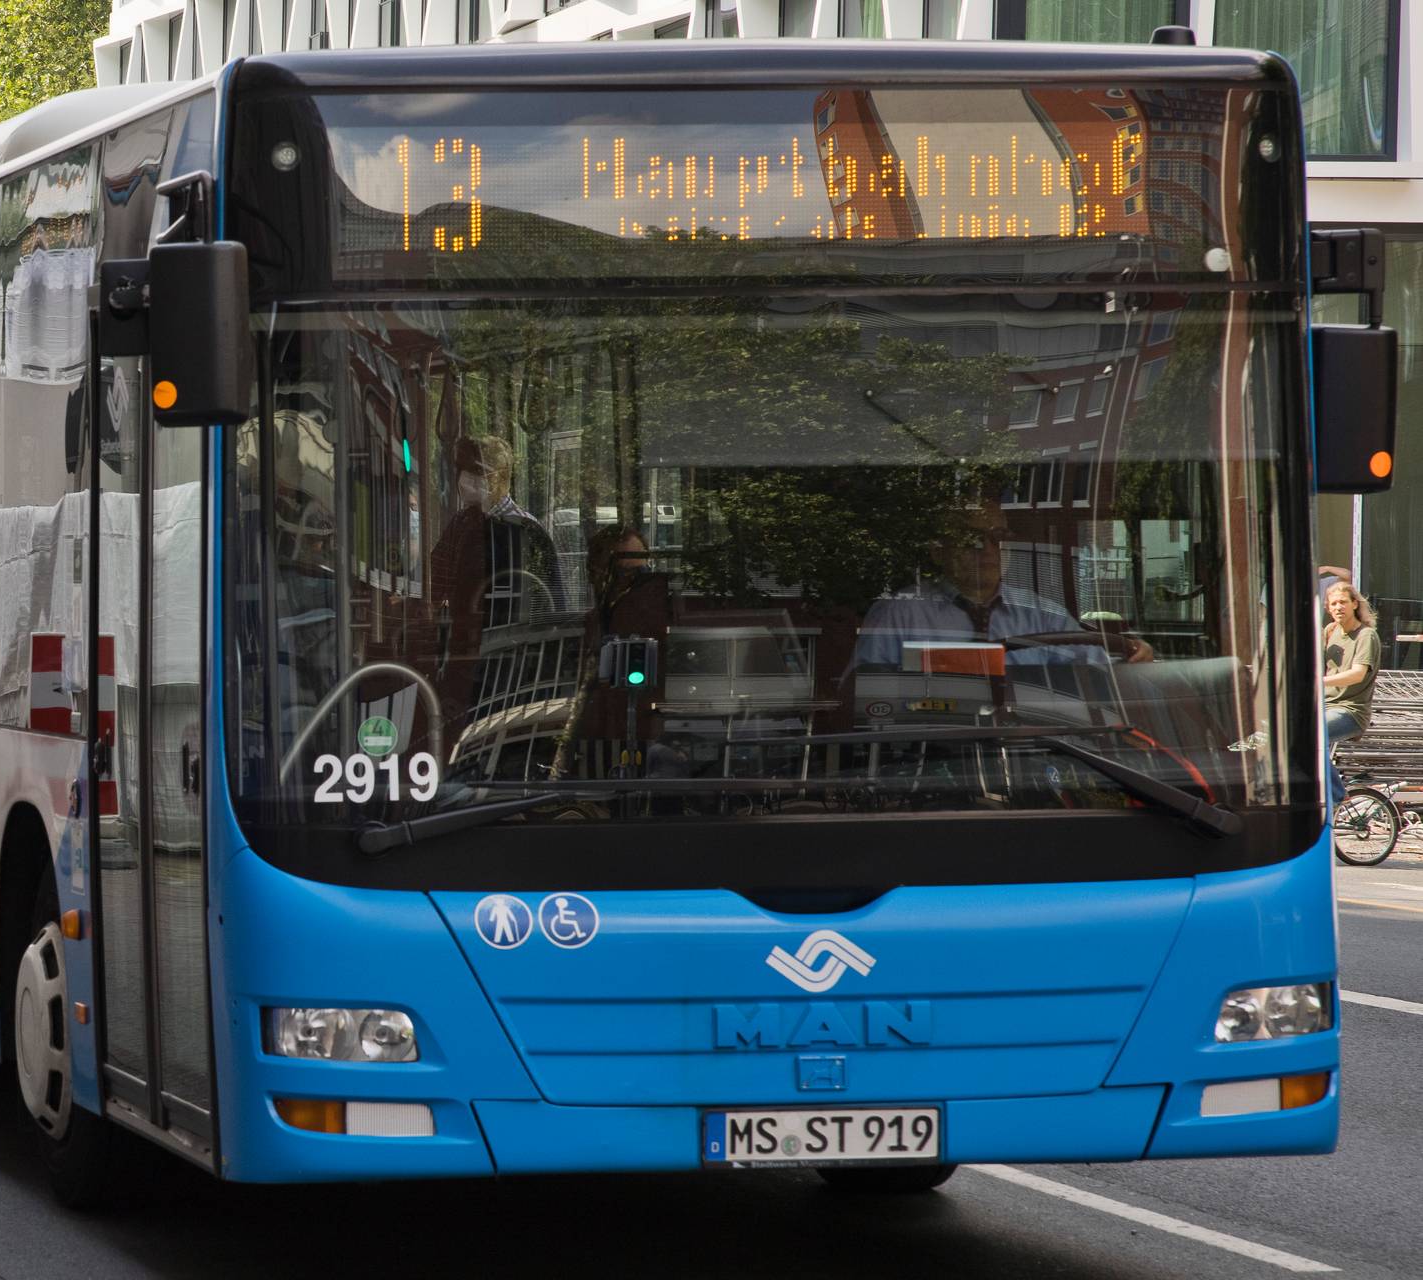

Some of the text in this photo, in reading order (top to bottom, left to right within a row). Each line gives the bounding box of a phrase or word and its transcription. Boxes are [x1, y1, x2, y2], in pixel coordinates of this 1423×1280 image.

[398, 138, 481, 251] 13
[583, 133, 1142, 207] Hauptbahnhof
[372, 719, 384, 737] 4
[313, 752, 439, 803] 2919
[712, 1001, 931, 1050] MAN
[730, 1115, 934, 1155] MS ST 919
